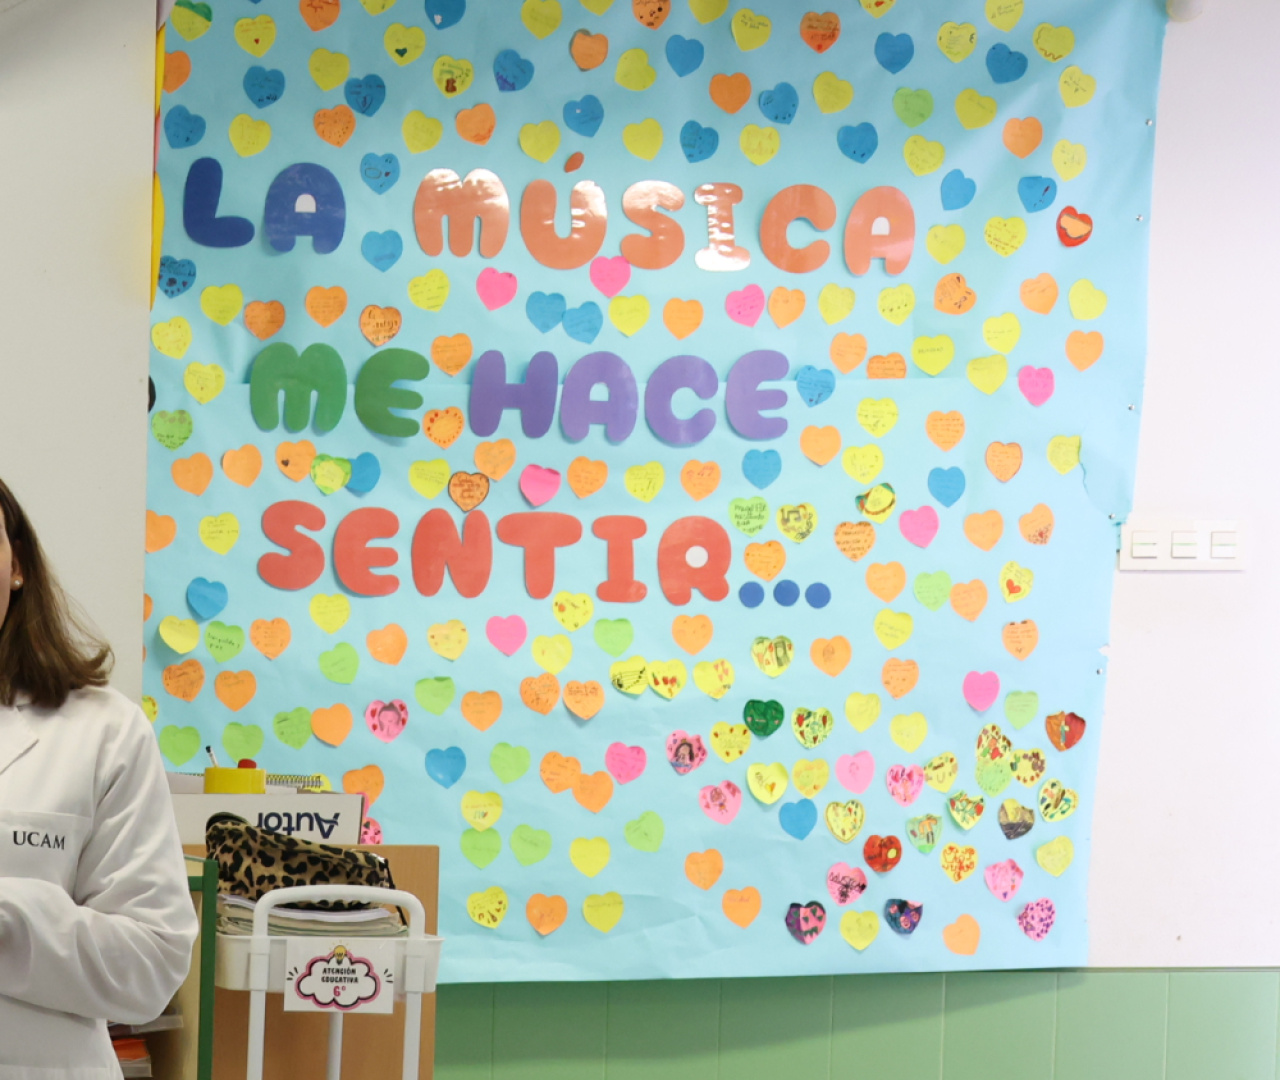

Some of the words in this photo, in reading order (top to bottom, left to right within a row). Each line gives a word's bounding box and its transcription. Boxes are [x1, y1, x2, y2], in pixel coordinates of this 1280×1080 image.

[182, 157, 346, 255] LA
[412, 150, 916, 276] MÚSICA
[249, 342, 430, 438] ME
[468, 349, 790, 447] HACE
[11, 830, 66, 851] UCAM
[320, 976, 359, 984] EDUCATIVA
[322, 966, 357, 975] ATENCIÓN
